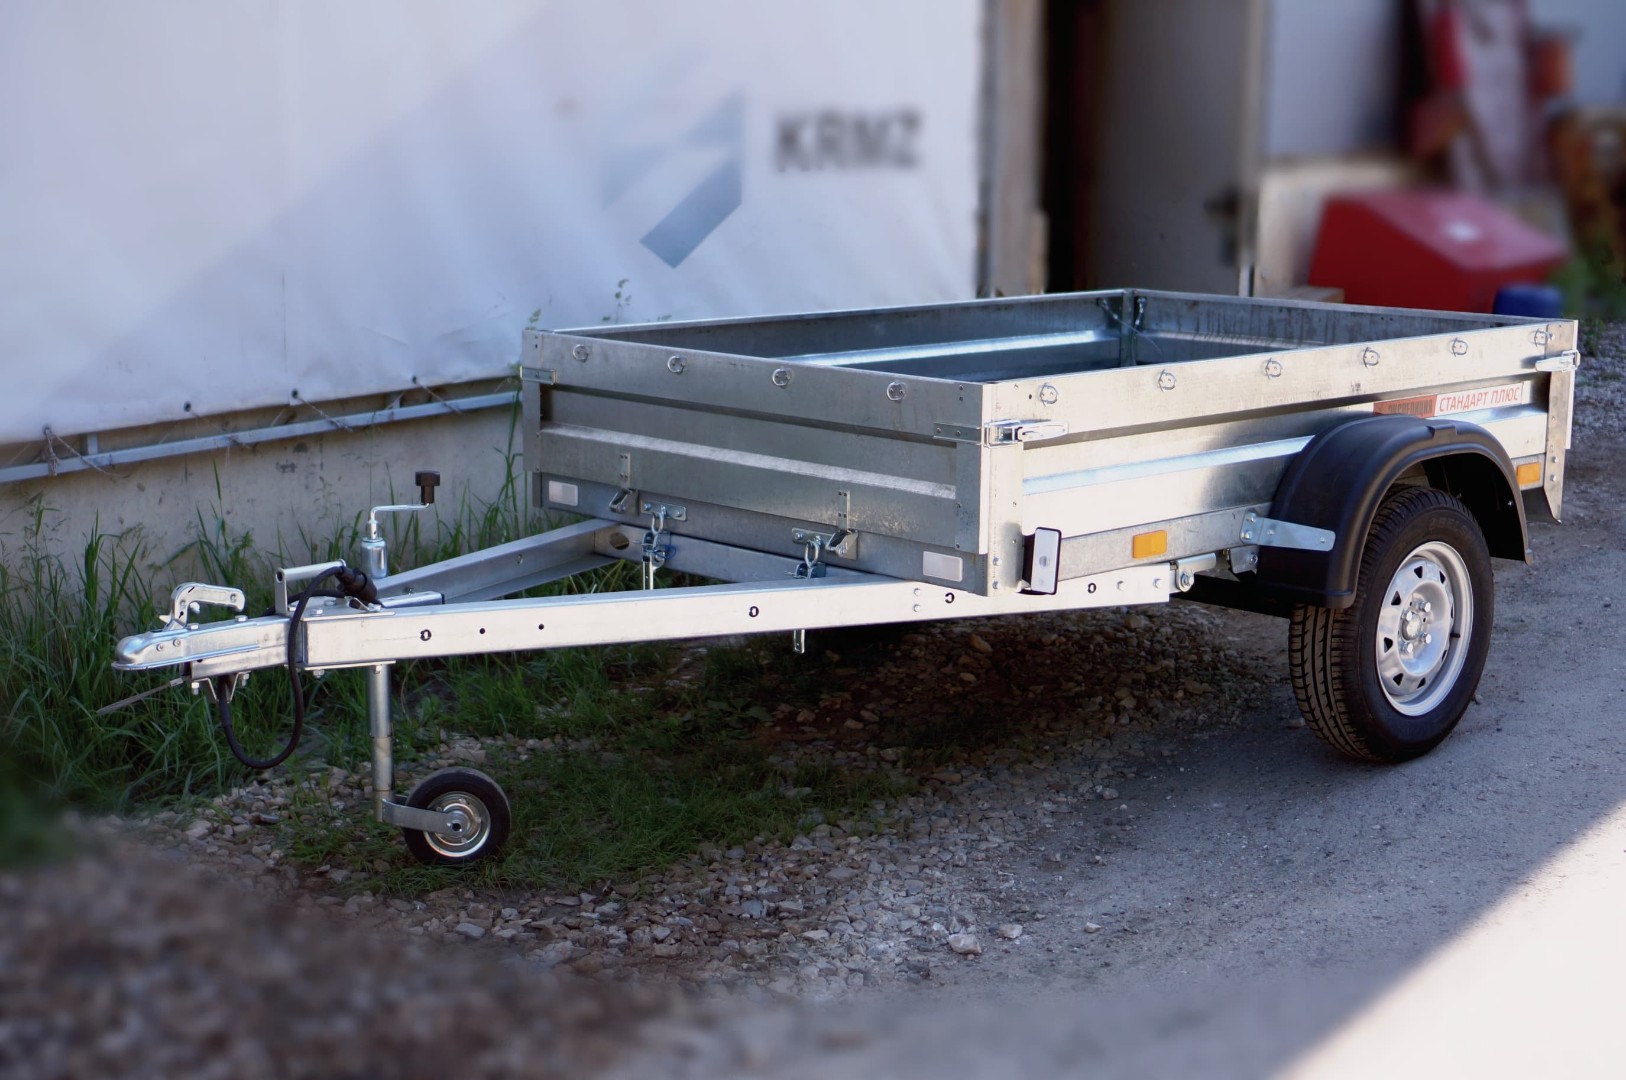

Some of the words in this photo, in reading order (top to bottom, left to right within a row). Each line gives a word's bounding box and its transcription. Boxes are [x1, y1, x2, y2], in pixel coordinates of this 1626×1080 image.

[775, 107, 922, 171] KRMZ
[1439, 391, 1489, 412] СТАНДАРТ
[1491, 387, 1520, 404] ПЛЮС
